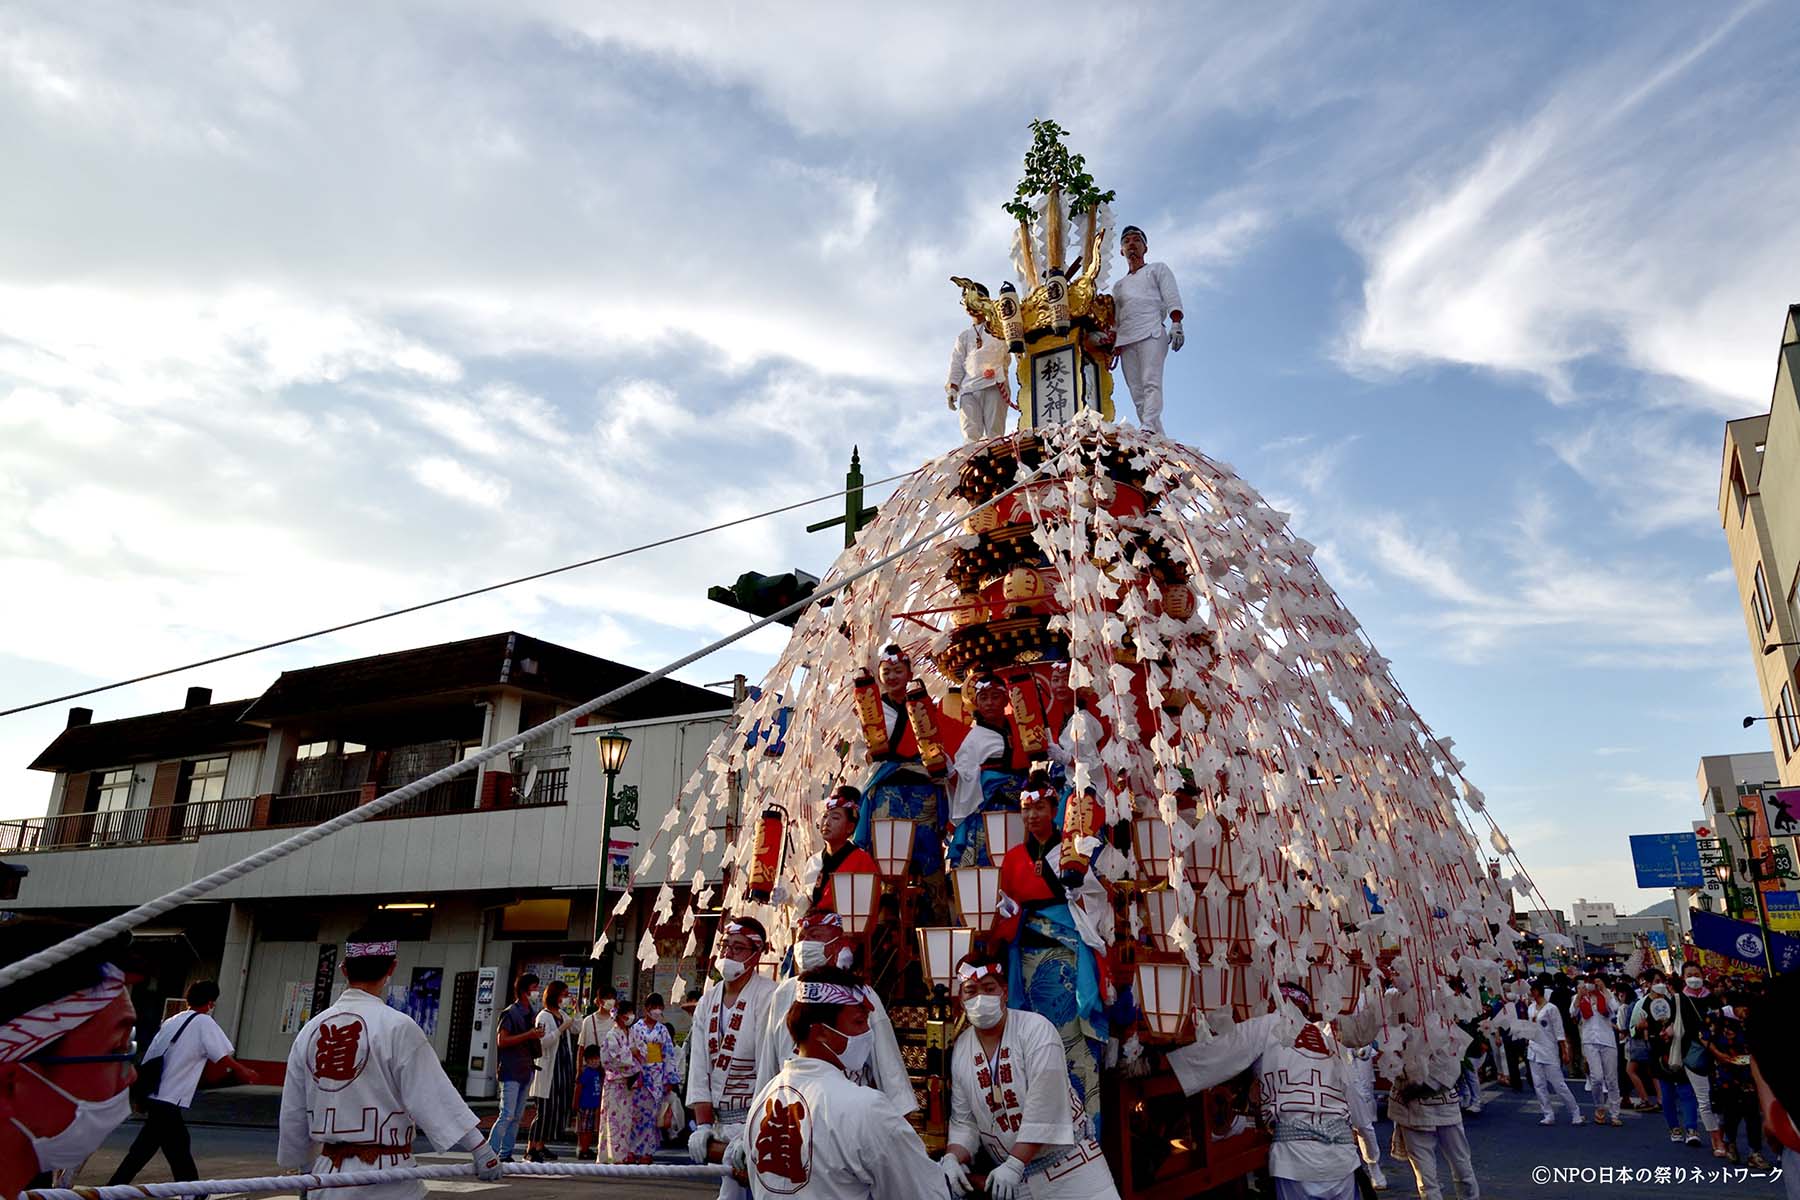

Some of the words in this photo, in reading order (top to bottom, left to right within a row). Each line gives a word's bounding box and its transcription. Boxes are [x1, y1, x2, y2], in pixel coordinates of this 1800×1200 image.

[626, 801, 636, 816] 34
[1777, 857, 1790, 869] 33
[1743, 895, 1753, 905] 32
[314, 1020, 363, 1081] 道
